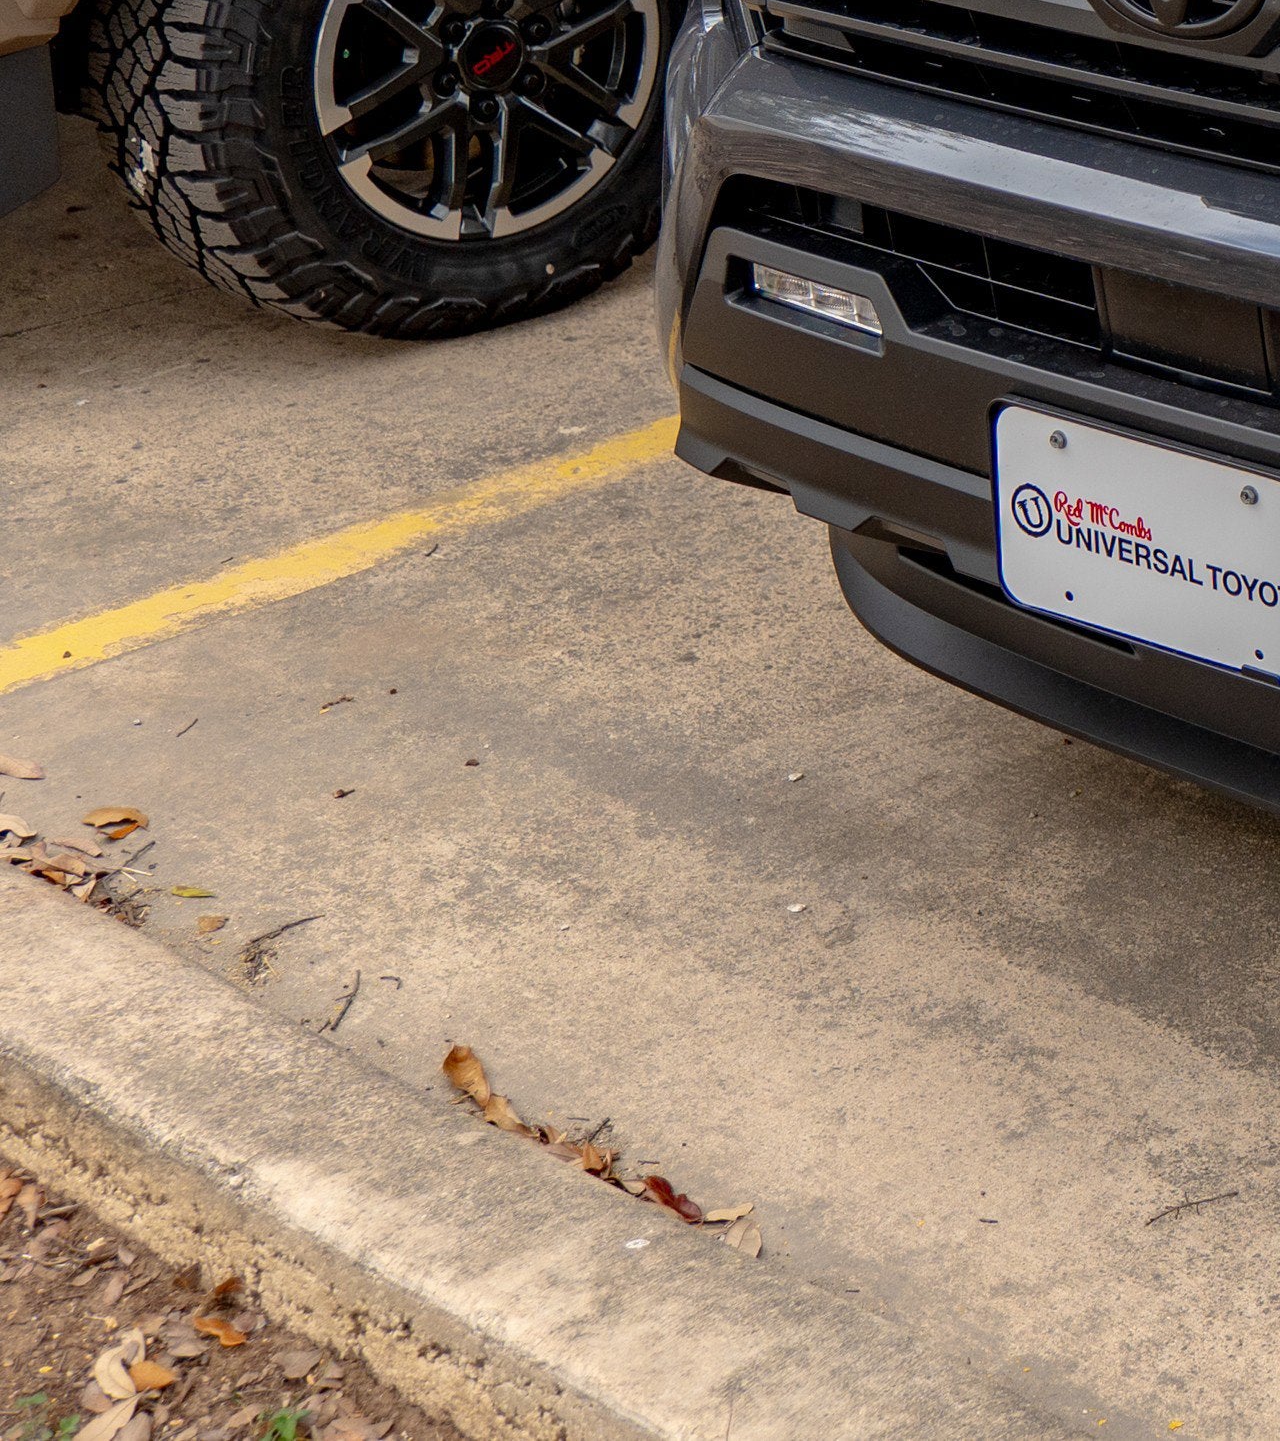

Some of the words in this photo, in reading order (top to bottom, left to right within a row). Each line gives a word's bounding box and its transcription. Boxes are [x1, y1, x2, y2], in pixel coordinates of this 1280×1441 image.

[472, 40, 517, 77] TRD
[1053, 490, 1084, 526] Red
[1084, 499, 1153, 542] McCombs
[1055, 518, 1204, 586] UNIVERSAL
